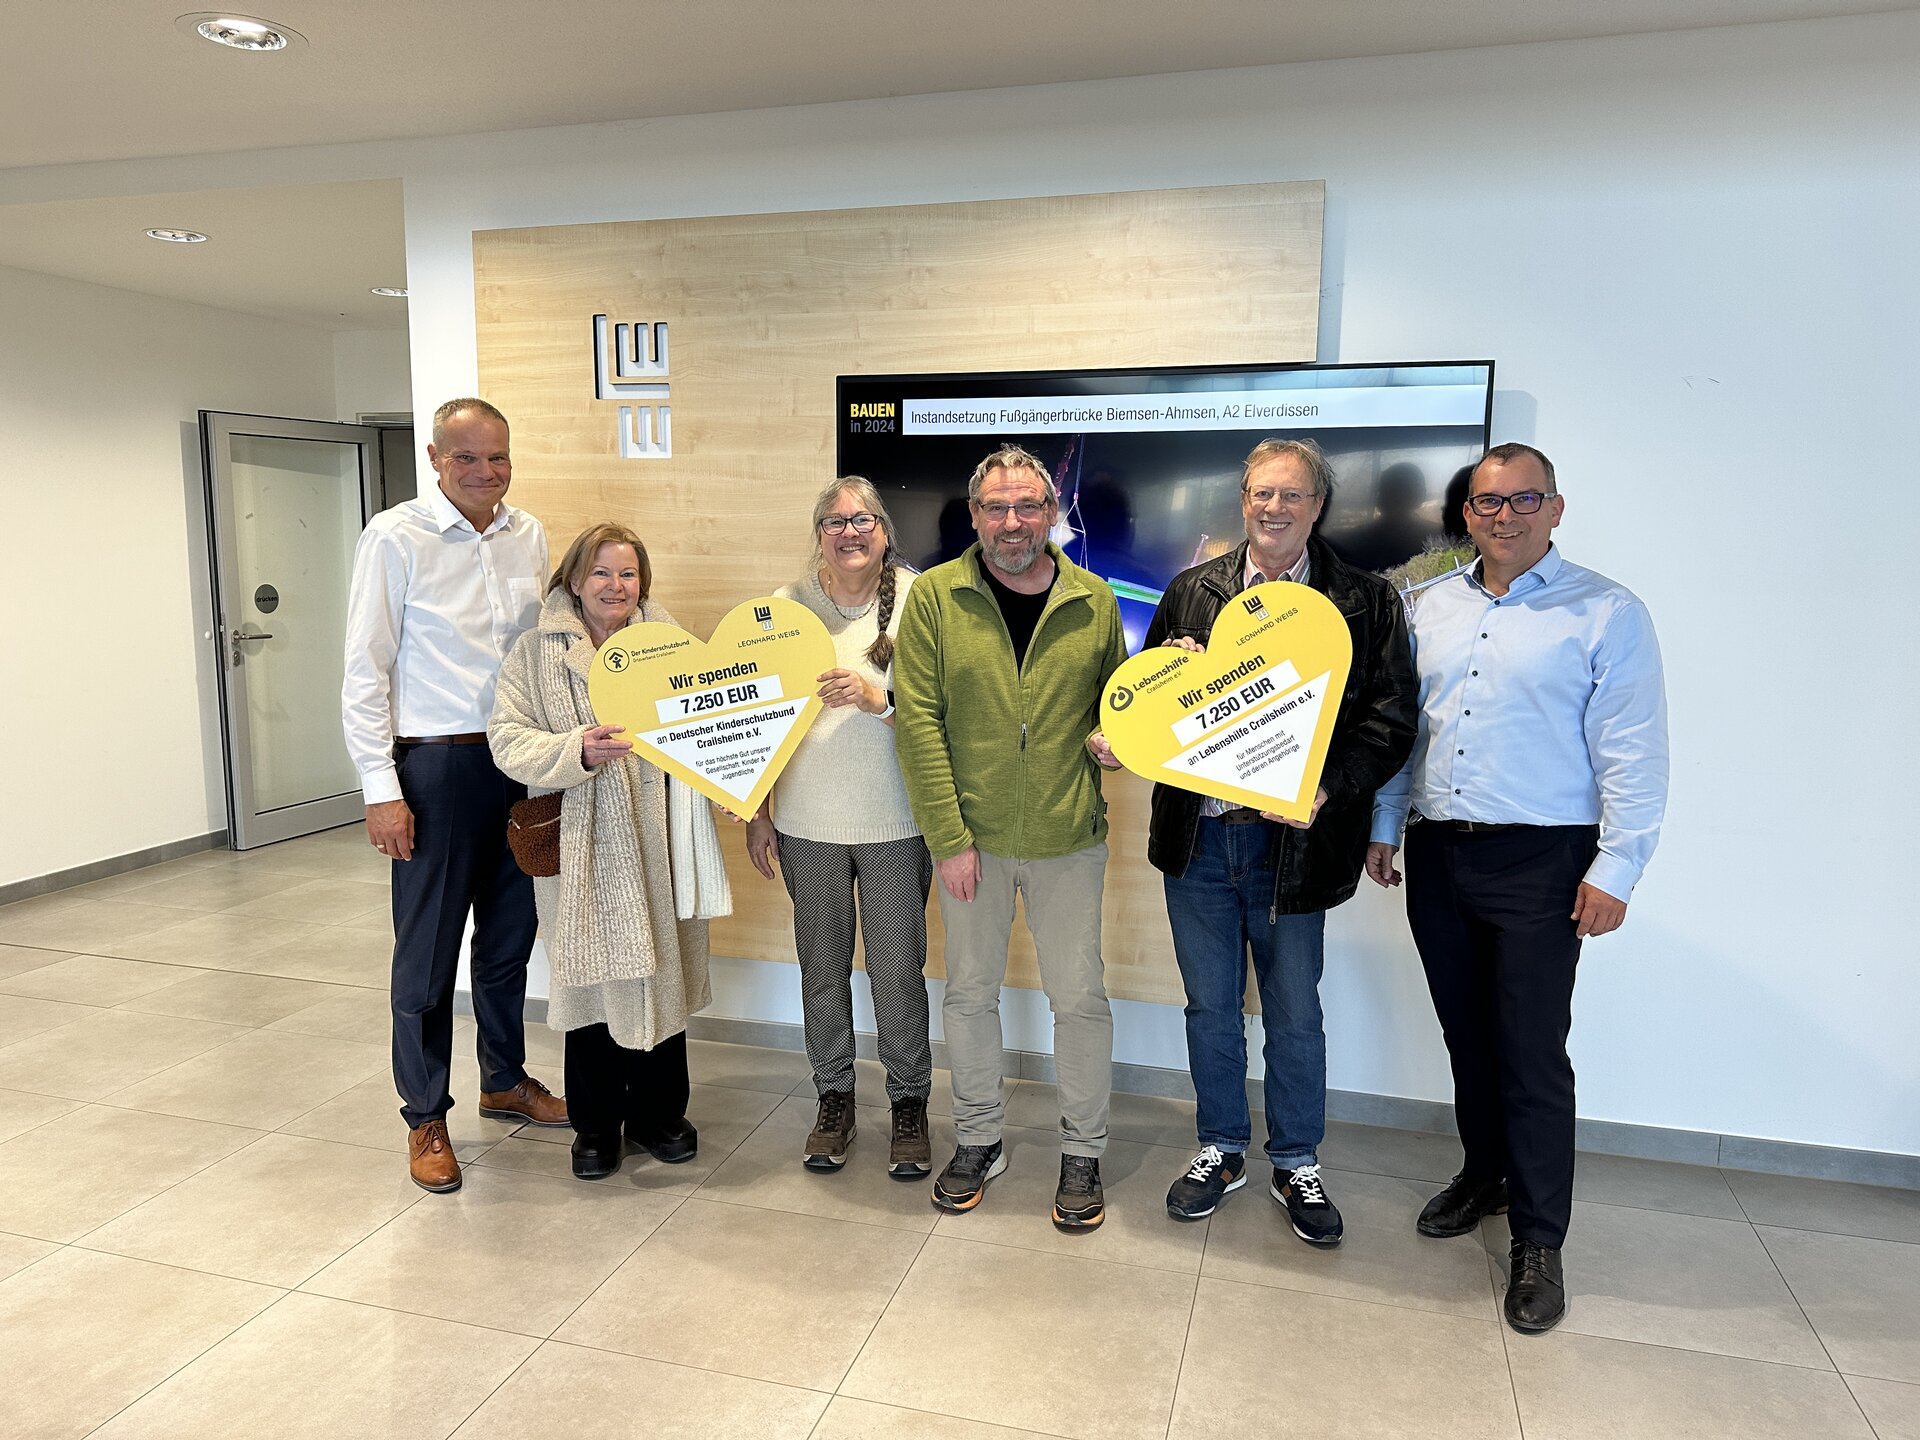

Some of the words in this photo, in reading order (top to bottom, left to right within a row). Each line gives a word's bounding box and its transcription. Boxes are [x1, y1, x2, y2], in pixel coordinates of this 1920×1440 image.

[850, 402, 895, 418] BAUEN
[911, 410, 996, 426] Instandsetzung
[1000, 407, 1102, 425] Fußgängerbrücke
[1107, 405, 1219, 421] Biemsen-Ahmsen,
[1223, 404, 1240, 418] A2
[1244, 403, 1319, 418] Elverdissen
[850, 420, 861, 432] in
[864, 419, 895, 433] 2024
[1236, 621, 1275, 646] LEONHARD
[1274, 607, 1299, 624] WEISS
[642, 640, 690, 655] Kinderschutzbund
[737, 634, 776, 648] LEONHARD
[777, 629, 801, 639] WEISS
[669, 673, 694, 690] Wir
[698, 661, 758, 686] spenden
[1133, 656, 1189, 691] Lebenshilfe
[1146, 676, 1173, 694] Crailsheim
[1177, 688, 1204, 710] Wir
[1205, 654, 1266, 694] spenden
[680, 691, 724, 714] 7.250
[727, 684, 759, 704] EUR
[1195, 696, 1241, 730] 7.250
[1239, 676, 1275, 705] EUR
[656, 735, 668, 745] an
[669, 724, 714, 742] Deutscher
[716, 706, 795, 731] Kinderschutzbund
[1187, 753, 1200, 767] an
[1198, 726, 1250, 760] Lebenshilfe
[1249, 700, 1298, 732] Crailsheim
[1297, 689, 1316, 705] e.V.
[696, 730, 744, 749] Crailsheim
[746, 727, 762, 738] e.V.
[1236, 752, 1246, 761] für
[1244, 736, 1275, 756] Menschen
[1274, 729, 1286, 740] mit
[695, 759, 704, 768] für
[705, 757, 716, 766] das
[716, 752, 739, 763] höchste
[739, 749, 750, 759] Gut
[750, 745, 772, 756] unserer
[741, 757, 760, 768] Kinder
[761, 755, 766, 763] &
[1235, 733, 1296, 772] Unterstützungsbedarf
[721, 767, 755, 781] Jugendliche
[1239, 769, 1252, 781] und
[1251, 760, 1269, 774] deren
